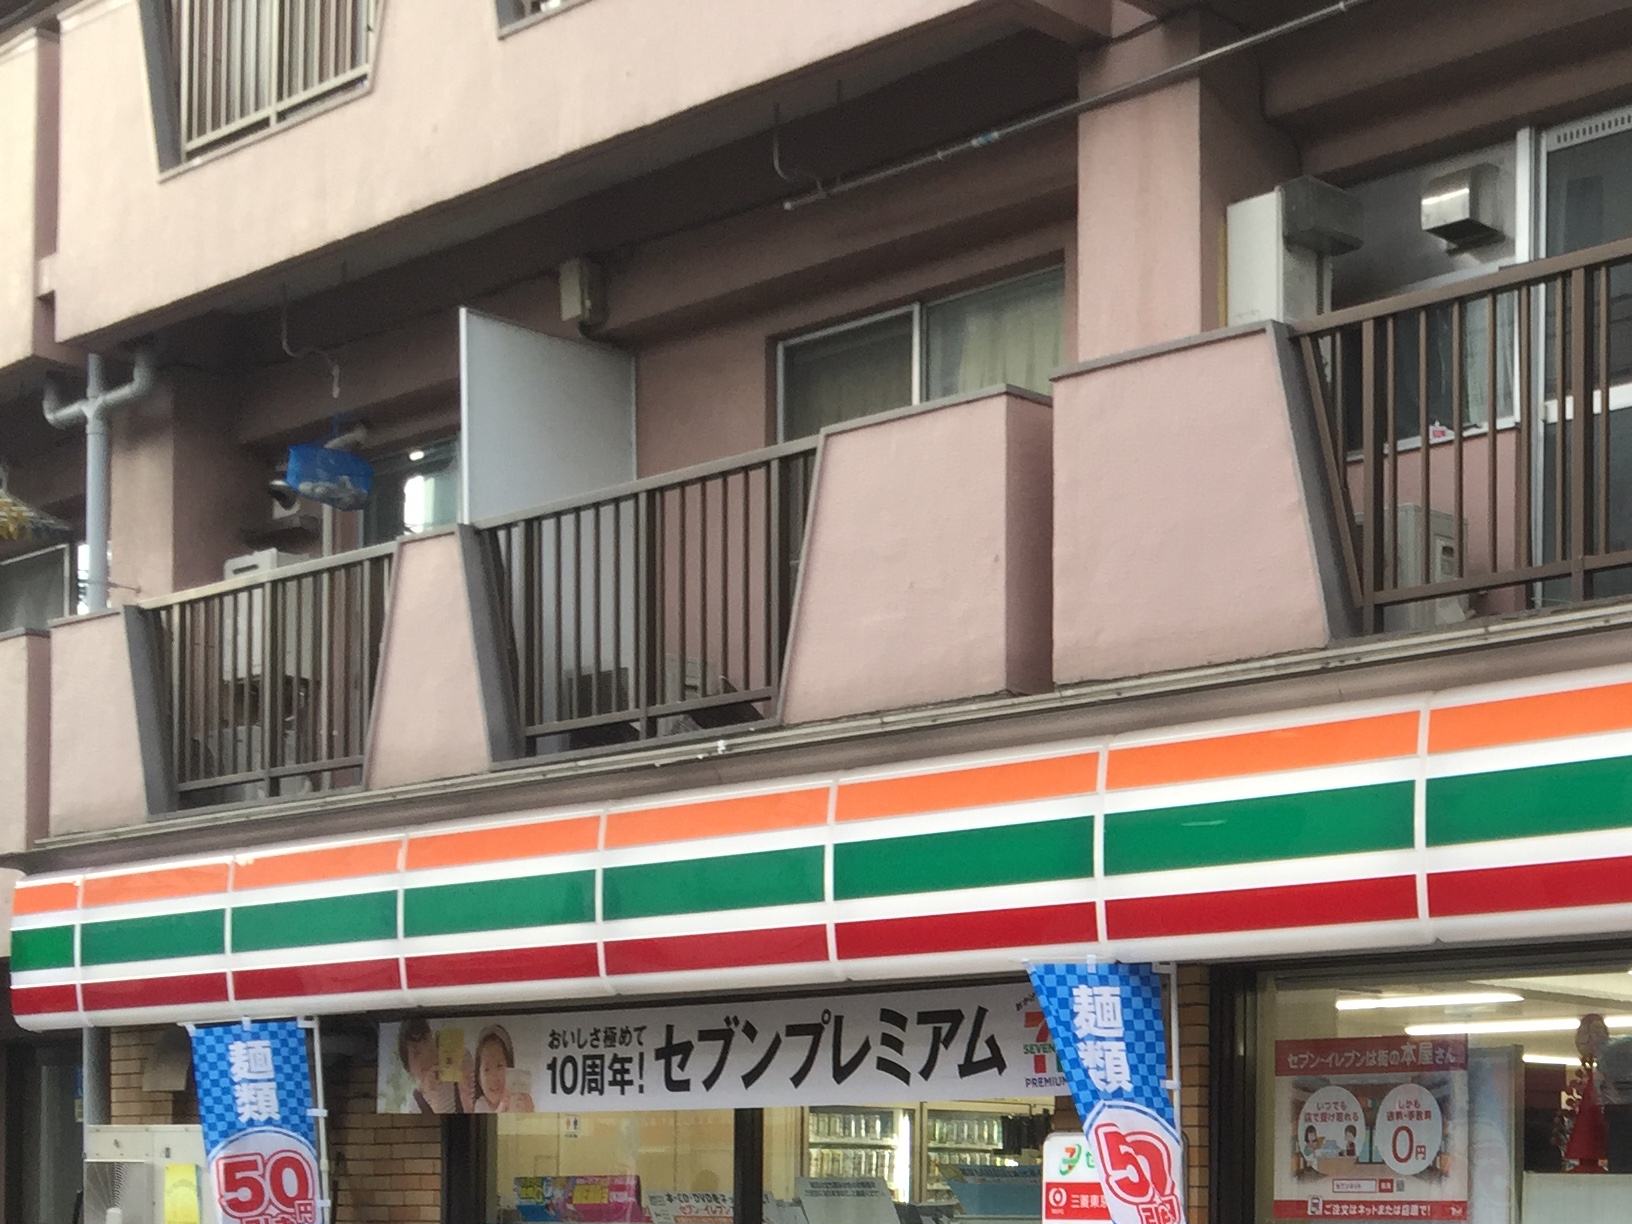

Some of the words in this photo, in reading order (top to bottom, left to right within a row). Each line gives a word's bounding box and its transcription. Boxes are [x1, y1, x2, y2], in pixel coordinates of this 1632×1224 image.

[546, 1051, 645, 1096] 10周年!
[548, 1025, 647, 1050] おいしさ極めて
[654, 1004, 1007, 1092] セブンプレミアム
[1072, 985, 1134, 1094] 麺類
[228, 1040, 281, 1123] 麺類
